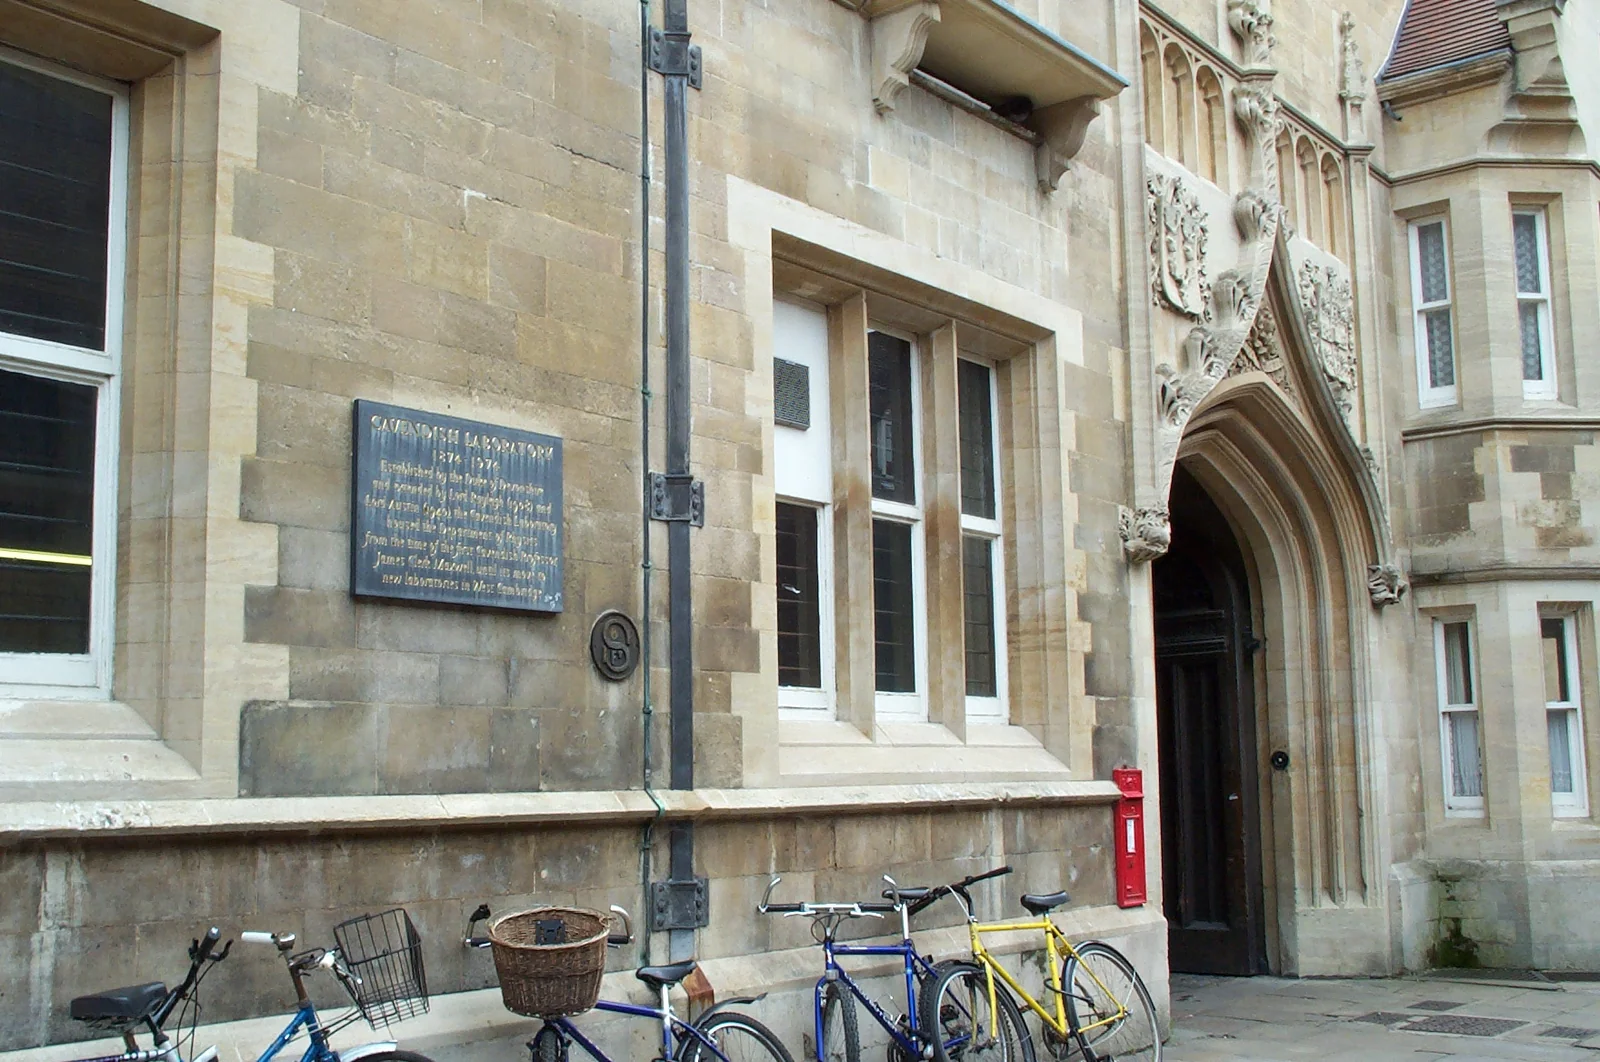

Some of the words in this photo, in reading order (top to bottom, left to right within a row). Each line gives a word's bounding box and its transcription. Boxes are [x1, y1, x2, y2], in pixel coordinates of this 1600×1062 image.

[371, 415, 459, 444] CAVENDISH
[464, 432, 553, 461] LABORATORY
[381, 459, 433, 479] Established
[436, 466, 447, 484] by
[449, 470, 463, 483] the
[465, 473, 487, 487] Duke
[490, 477, 500, 496] of
[500, 479, 544, 496] Devonshire
[373, 479, 391, 491] and
[394, 483, 433, 497] extended
[436, 485, 446, 503] by
[448, 488, 468, 502] Lord
[471, 491, 504, 510] Rayleigh
[536, 502, 552, 514] and
[365, 494, 386, 509] Lord
[388, 500, 420, 513] Austin
[454, 507, 467, 519] the
[470, 509, 512, 526] Cavendish
[513, 515, 557, 536] Laboratory
[387, 515, 420, 531] housed
[422, 521, 437, 533] the
[439, 523, 493, 541] Department
[495, 530, 506, 546] of
[506, 531, 538, 548] Physics
[362, 531, 388, 549] from
[391, 535, 405, 547] the
[408, 538, 427, 551] time
[429, 540, 439, 557] of
[441, 541, 453, 554] the
[452, 541, 474, 559] first
[476, 545, 518, 561] Cavendish
[373, 551, 405, 569] James
[408, 554, 431, 569] Clerk
[476, 563, 497, 577] until
[499, 566, 510, 577] its
[513, 569, 534, 580] move
[537, 571, 546, 581] to
[382, 574, 402, 586] new
[405, 571, 460, 590] laboratories
[461, 581, 470, 592] in
[472, 580, 494, 594] West
[497, 583, 543, 602] Cambridge
